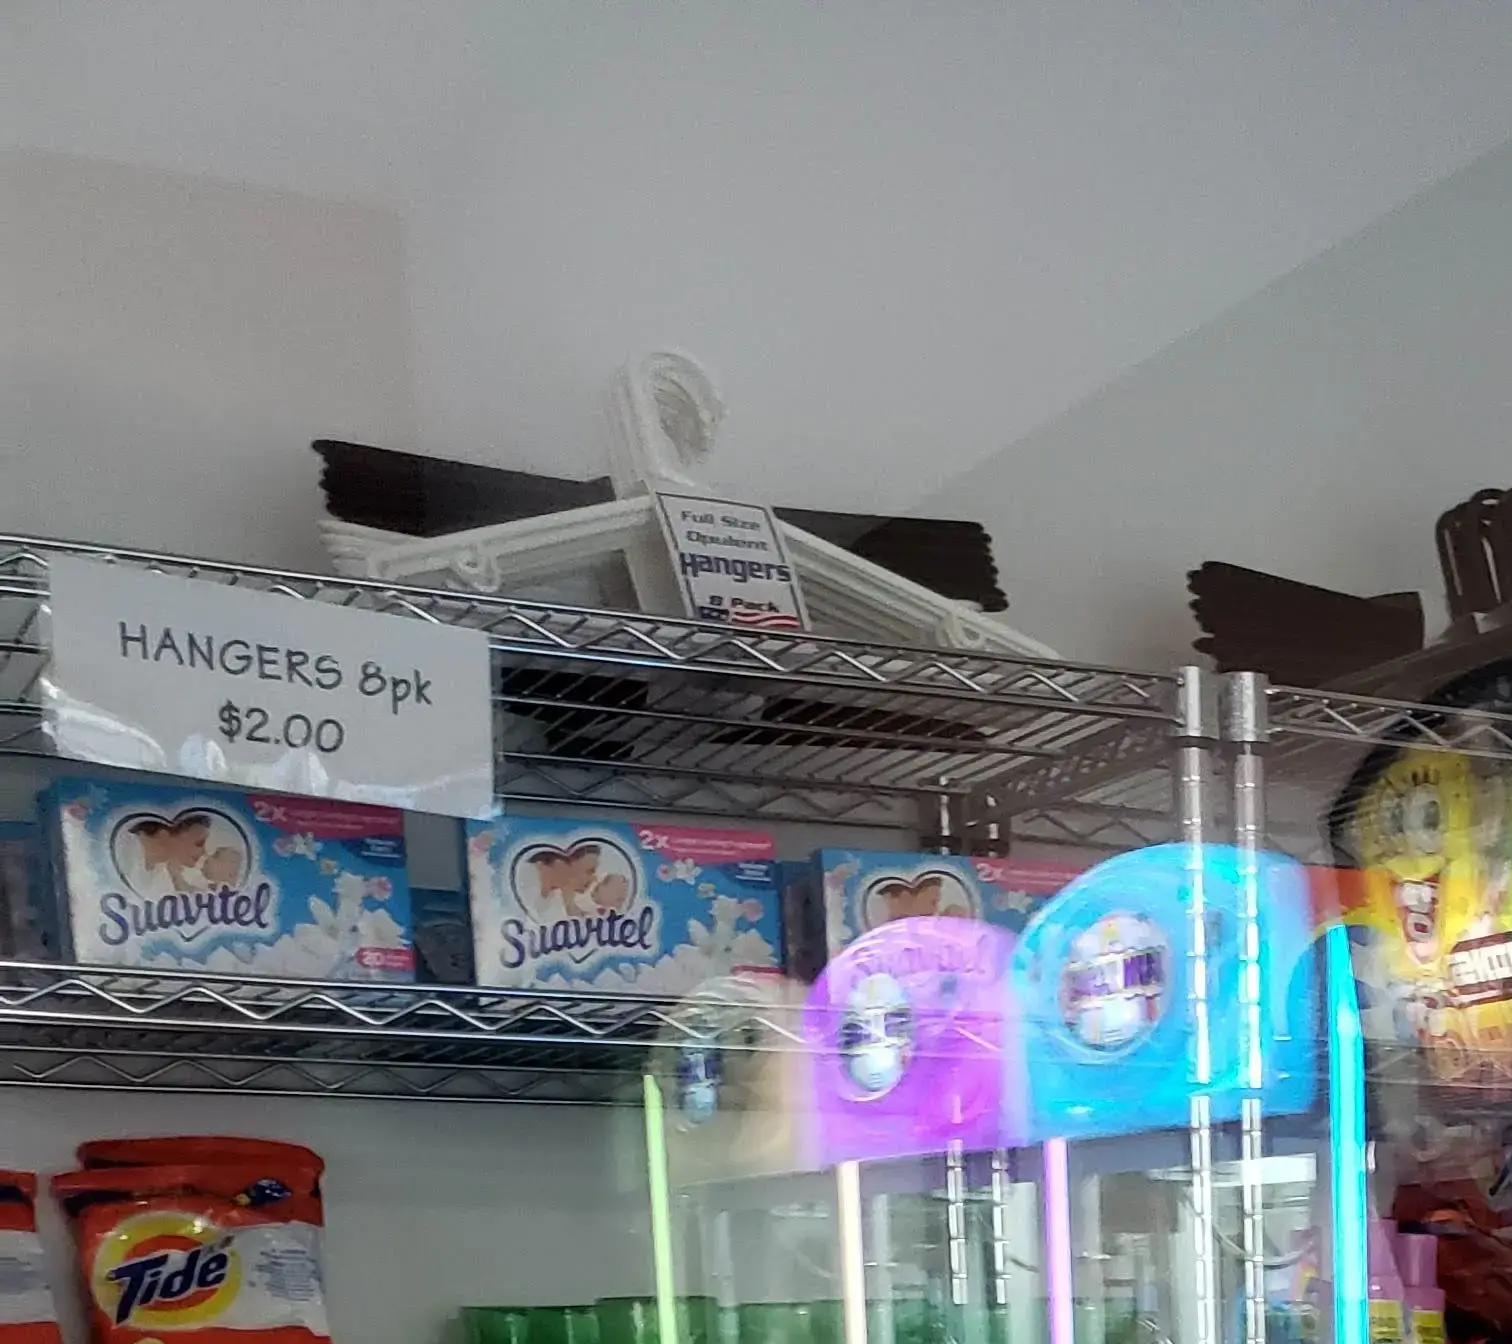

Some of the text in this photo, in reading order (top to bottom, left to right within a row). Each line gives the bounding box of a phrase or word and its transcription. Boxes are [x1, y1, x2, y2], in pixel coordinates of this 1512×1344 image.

[679, 552, 793, 584] Hangers
[119, 620, 433, 716] HANGERS 8pk
[217, 699, 346, 753] $2.00
[100, 883, 271, 945] Suavitel
[501, 906, 653, 968] Suavitel
[107, 1249, 229, 1325] Tide
